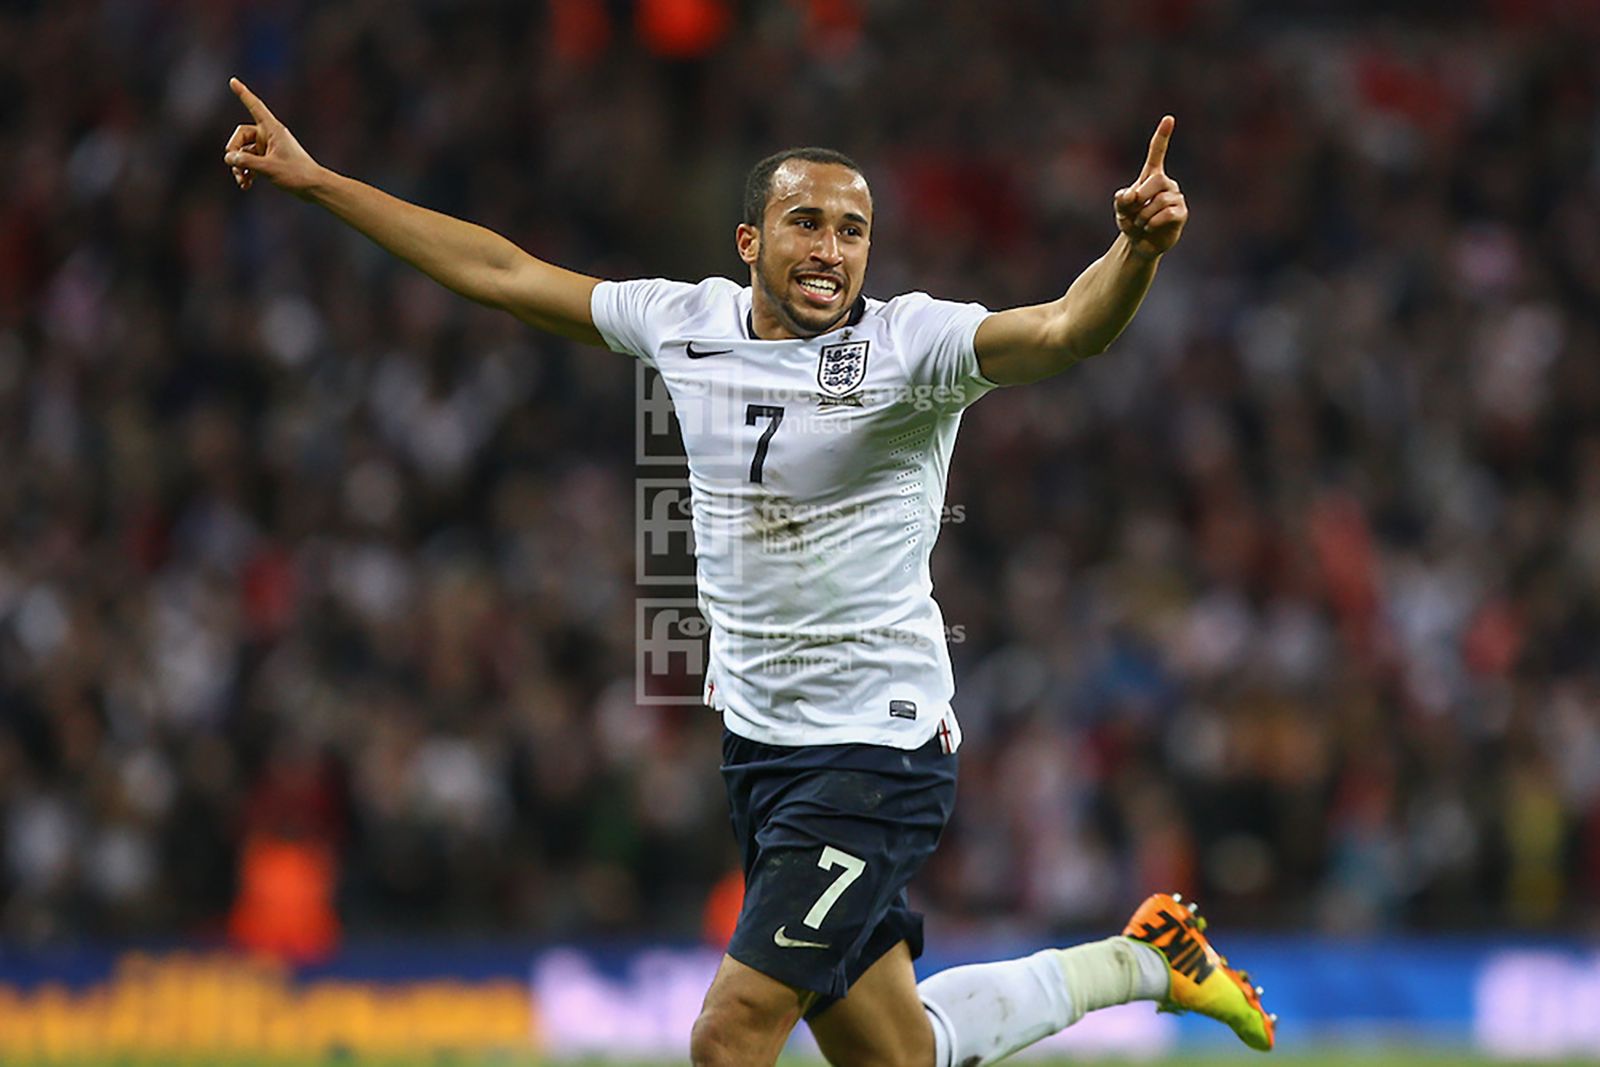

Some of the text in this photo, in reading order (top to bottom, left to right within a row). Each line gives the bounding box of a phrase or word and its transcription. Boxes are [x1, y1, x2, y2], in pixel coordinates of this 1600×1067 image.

[745, 404, 785, 484] 7
[803, 845, 866, 930] 7
[1128, 910, 1216, 985] NIKE
